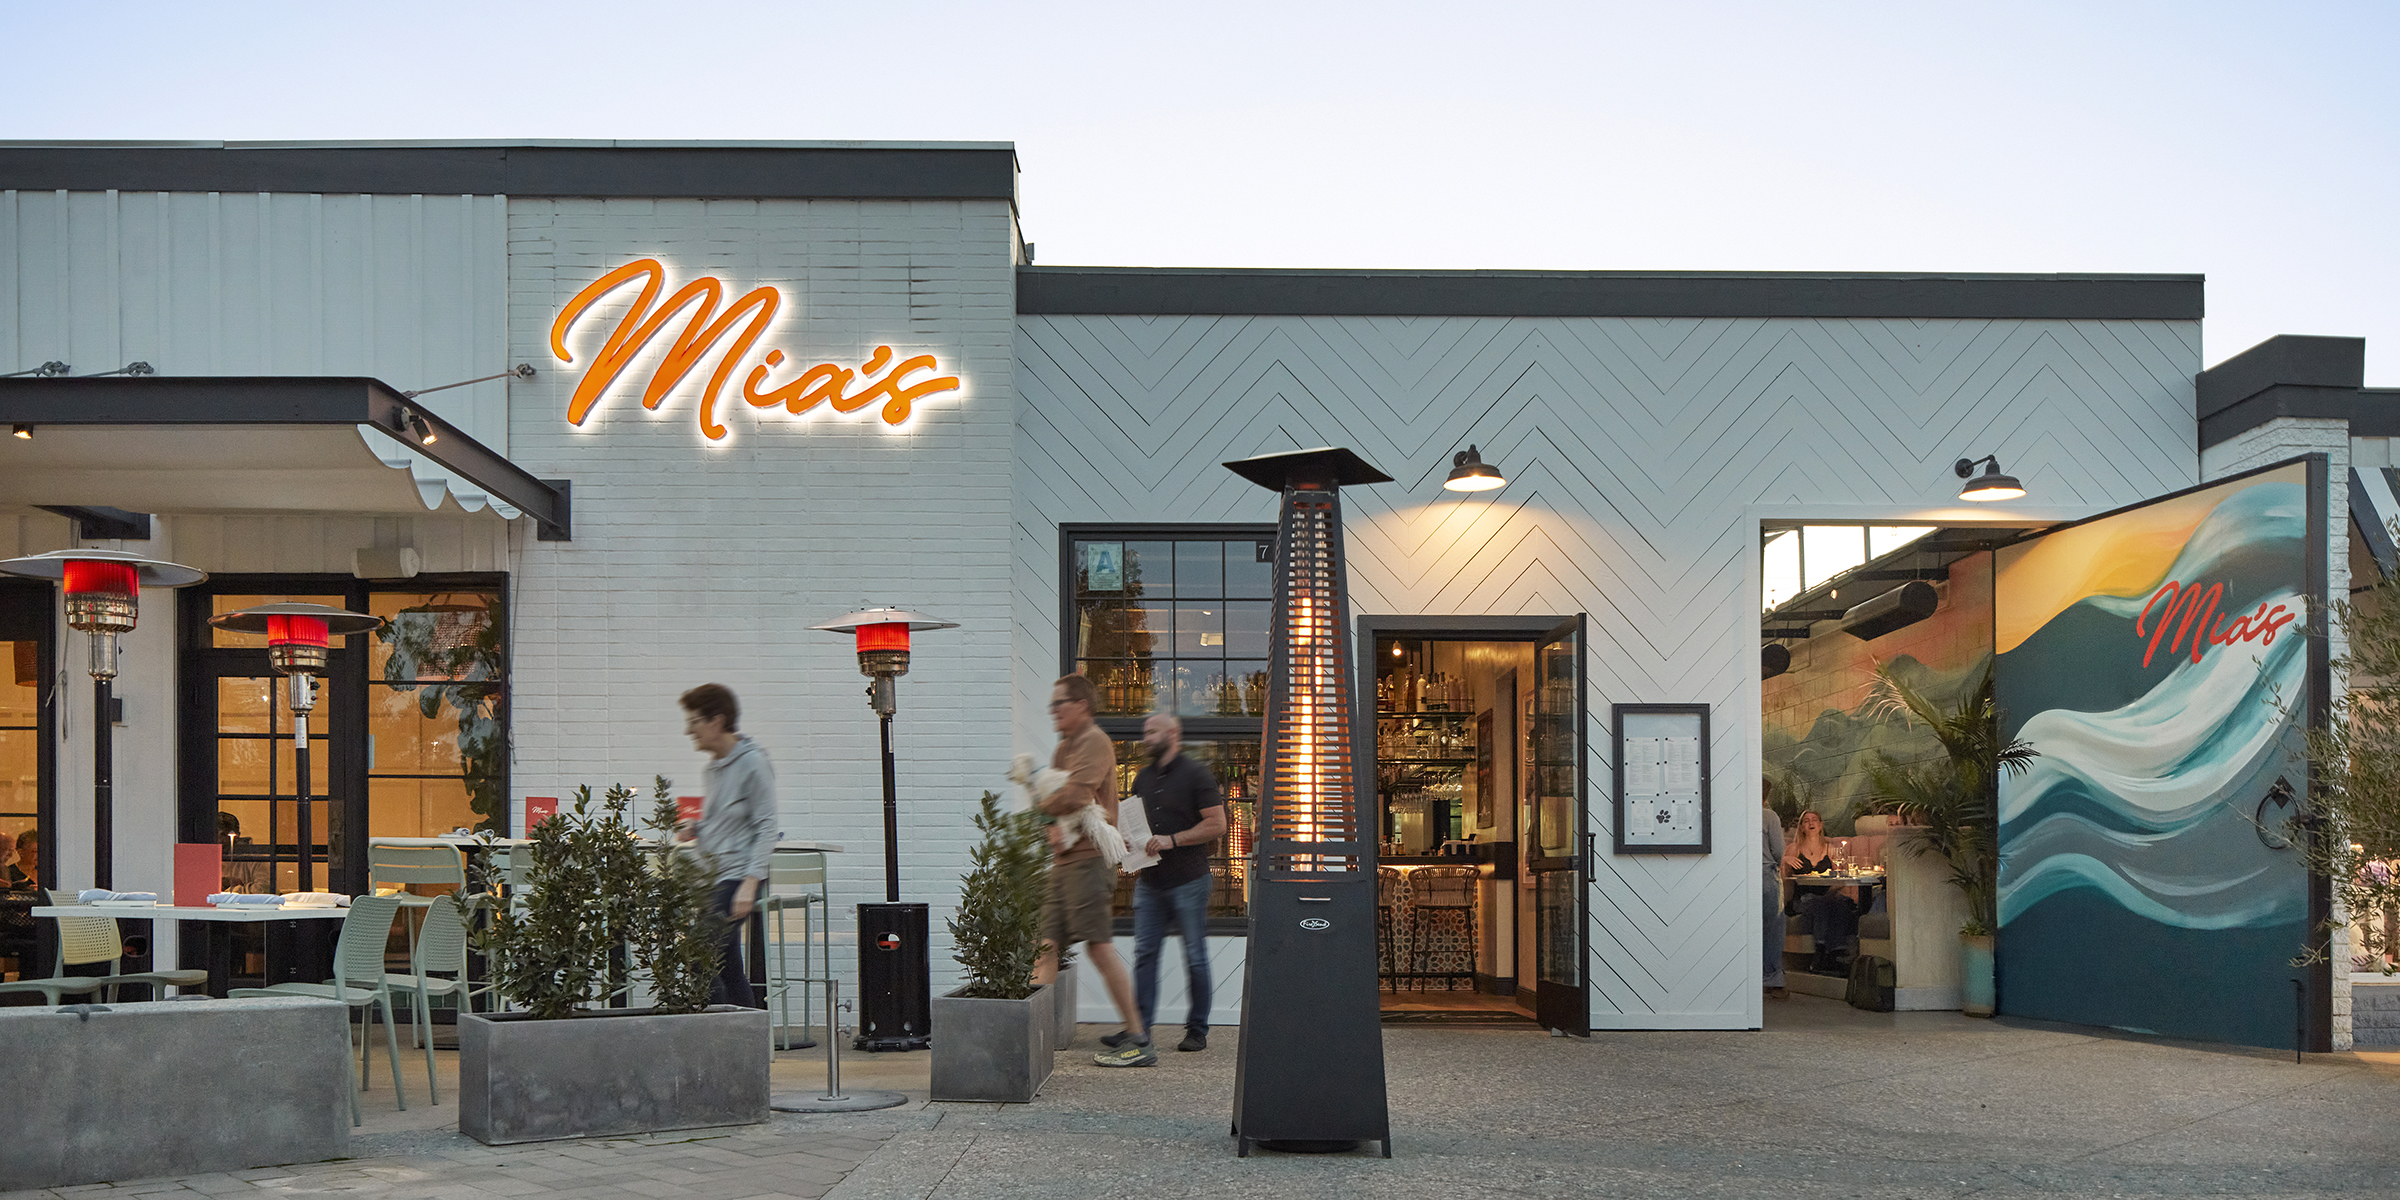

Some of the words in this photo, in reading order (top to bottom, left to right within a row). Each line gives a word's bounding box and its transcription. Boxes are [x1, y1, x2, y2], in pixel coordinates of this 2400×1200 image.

[550, 258, 960, 441] Mia's
[1096, 550, 1116, 573] A
[1259, 545, 1269, 559] 7
[2136, 580, 2295, 668] Mia's
